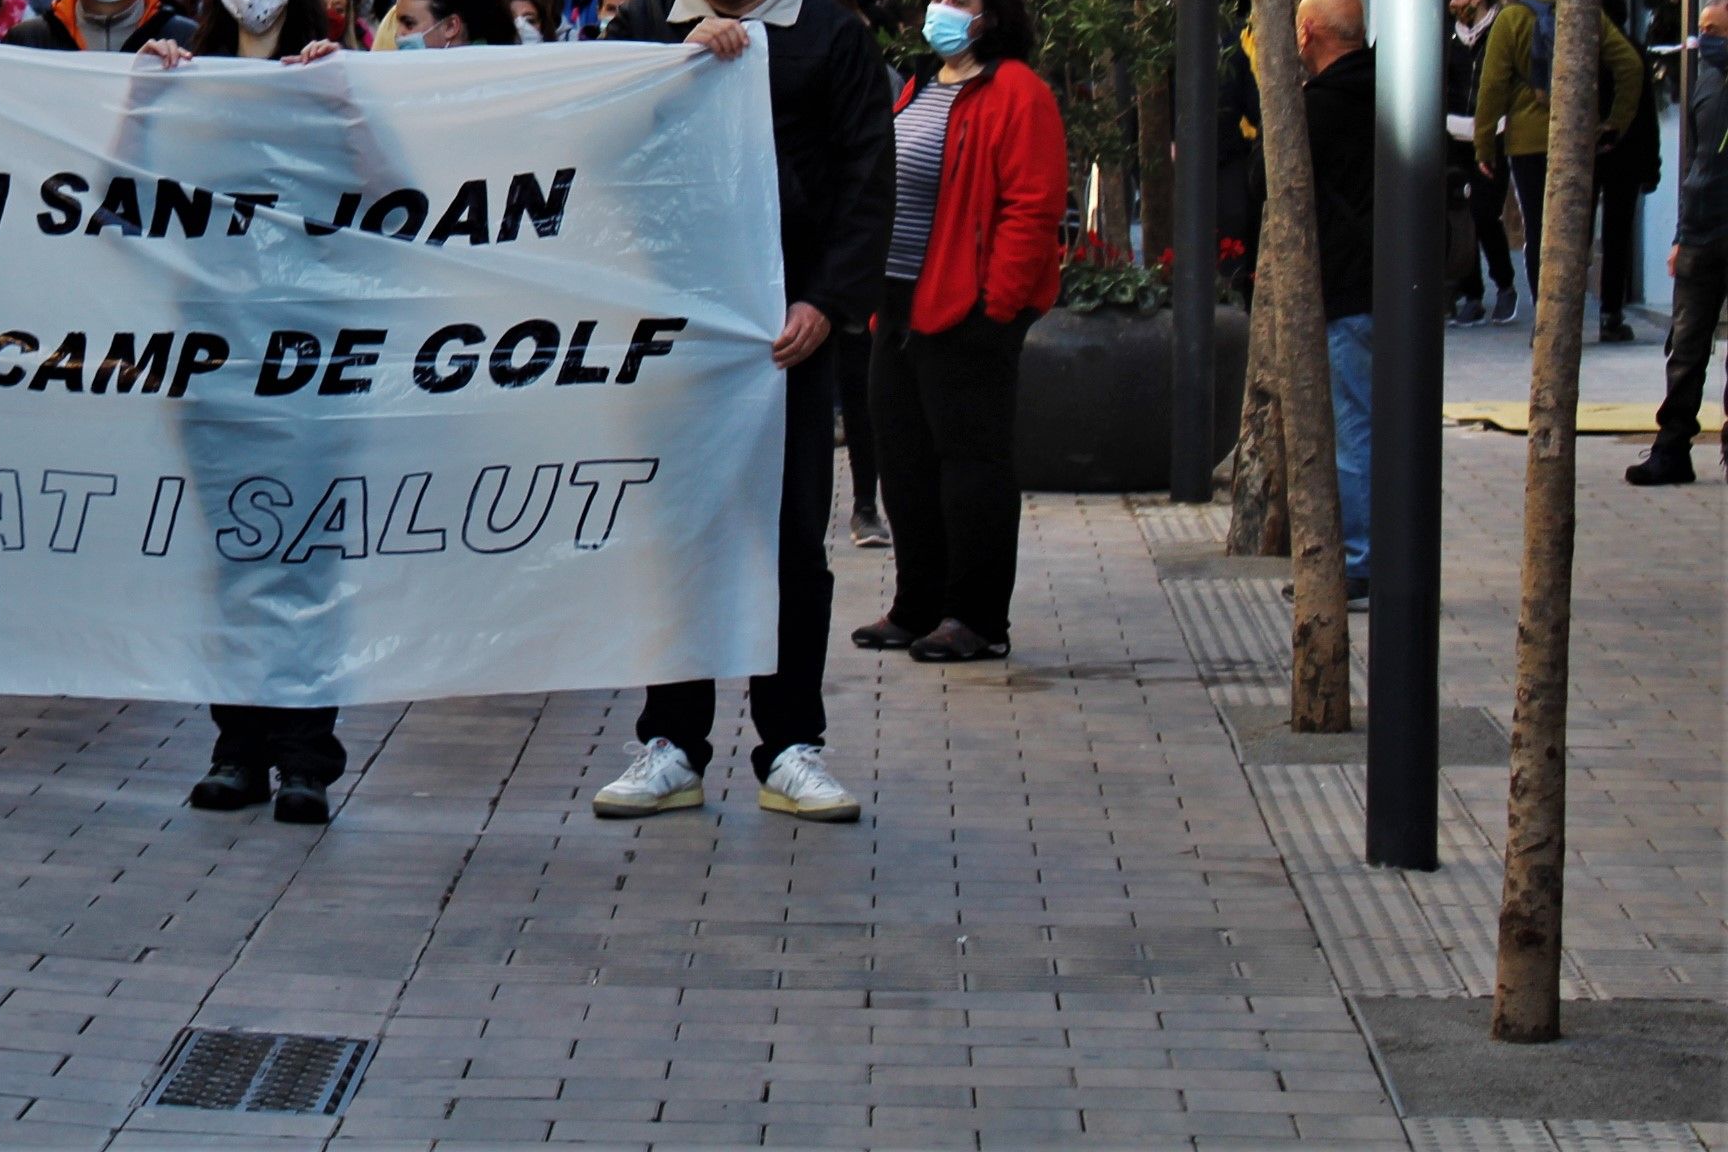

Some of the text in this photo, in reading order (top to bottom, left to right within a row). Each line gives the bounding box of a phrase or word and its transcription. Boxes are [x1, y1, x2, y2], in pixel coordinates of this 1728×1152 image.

[36, 171, 278, 239] SANT
[304, 166, 577, 247] JOAN
[253, 328, 388, 397] DE
[412, 317, 688, 394] GOLF
[141, 476, 186, 556] I
[215, 456, 660, 564] SALUT
